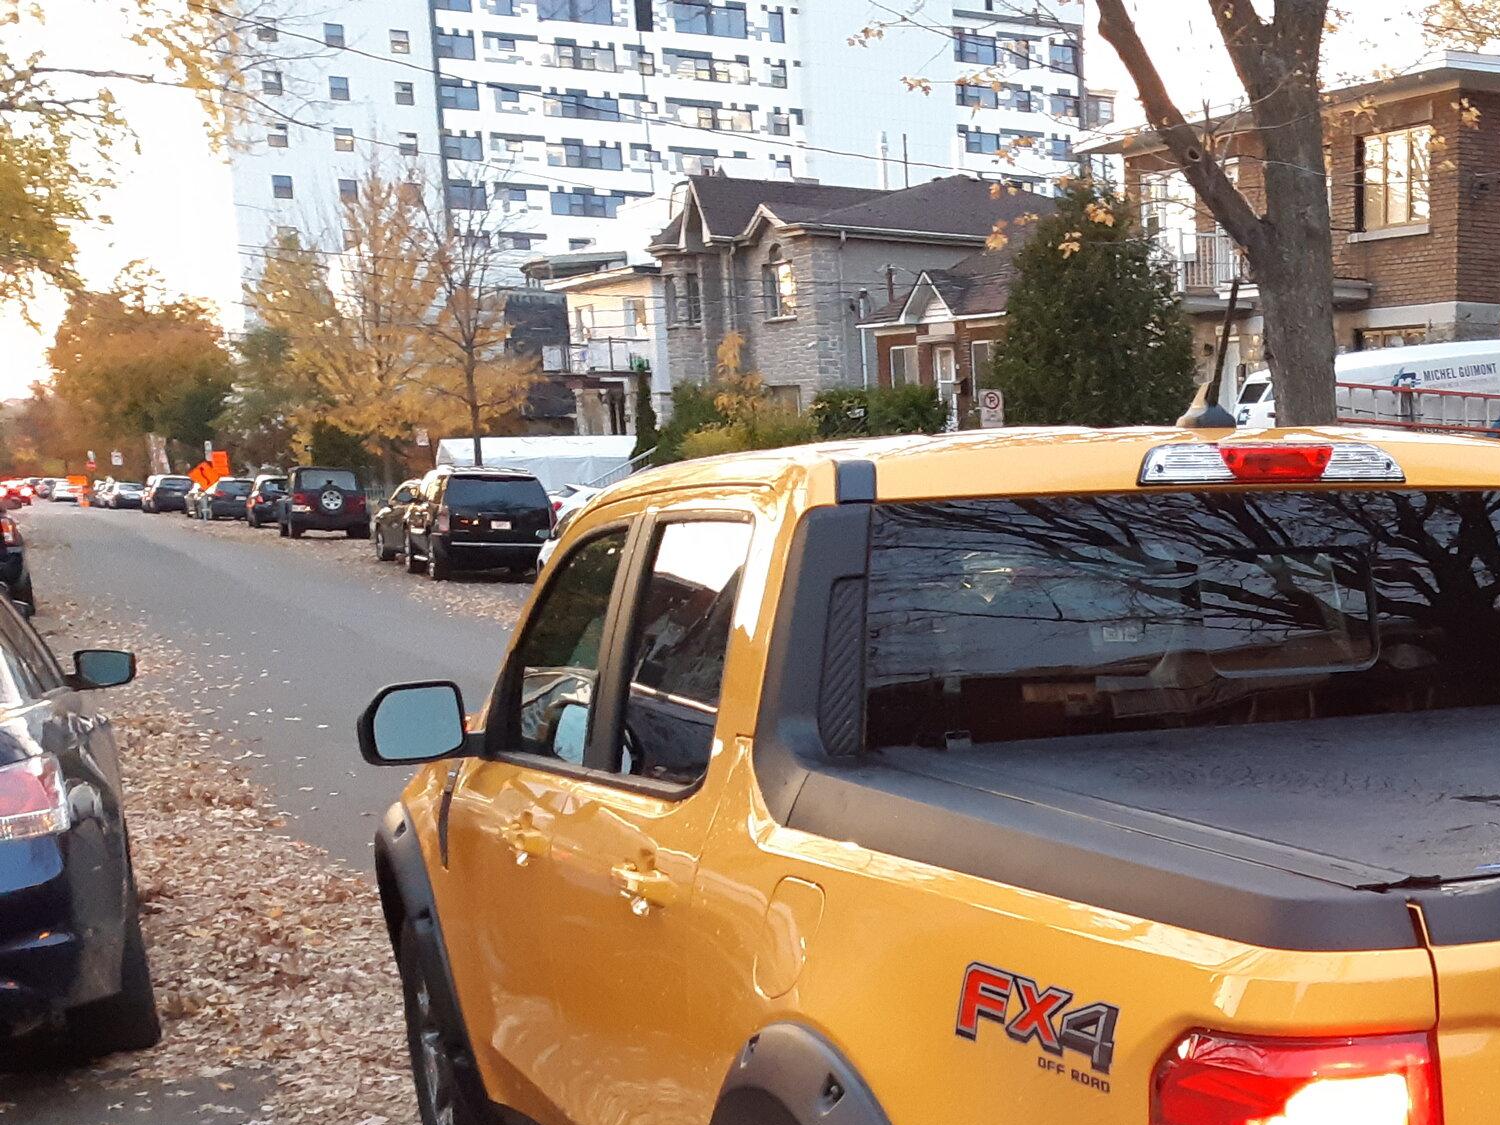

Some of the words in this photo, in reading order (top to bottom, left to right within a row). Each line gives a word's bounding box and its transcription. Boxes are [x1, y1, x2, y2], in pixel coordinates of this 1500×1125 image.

[1423, 367, 1457, 381] MICHEL
[1459, 363, 1496, 377] GUIMONT
[955, 961, 1119, 1075] FX4
[1038, 1056, 1065, 1076] OFF
[1071, 1069, 1110, 1093] ROAD
